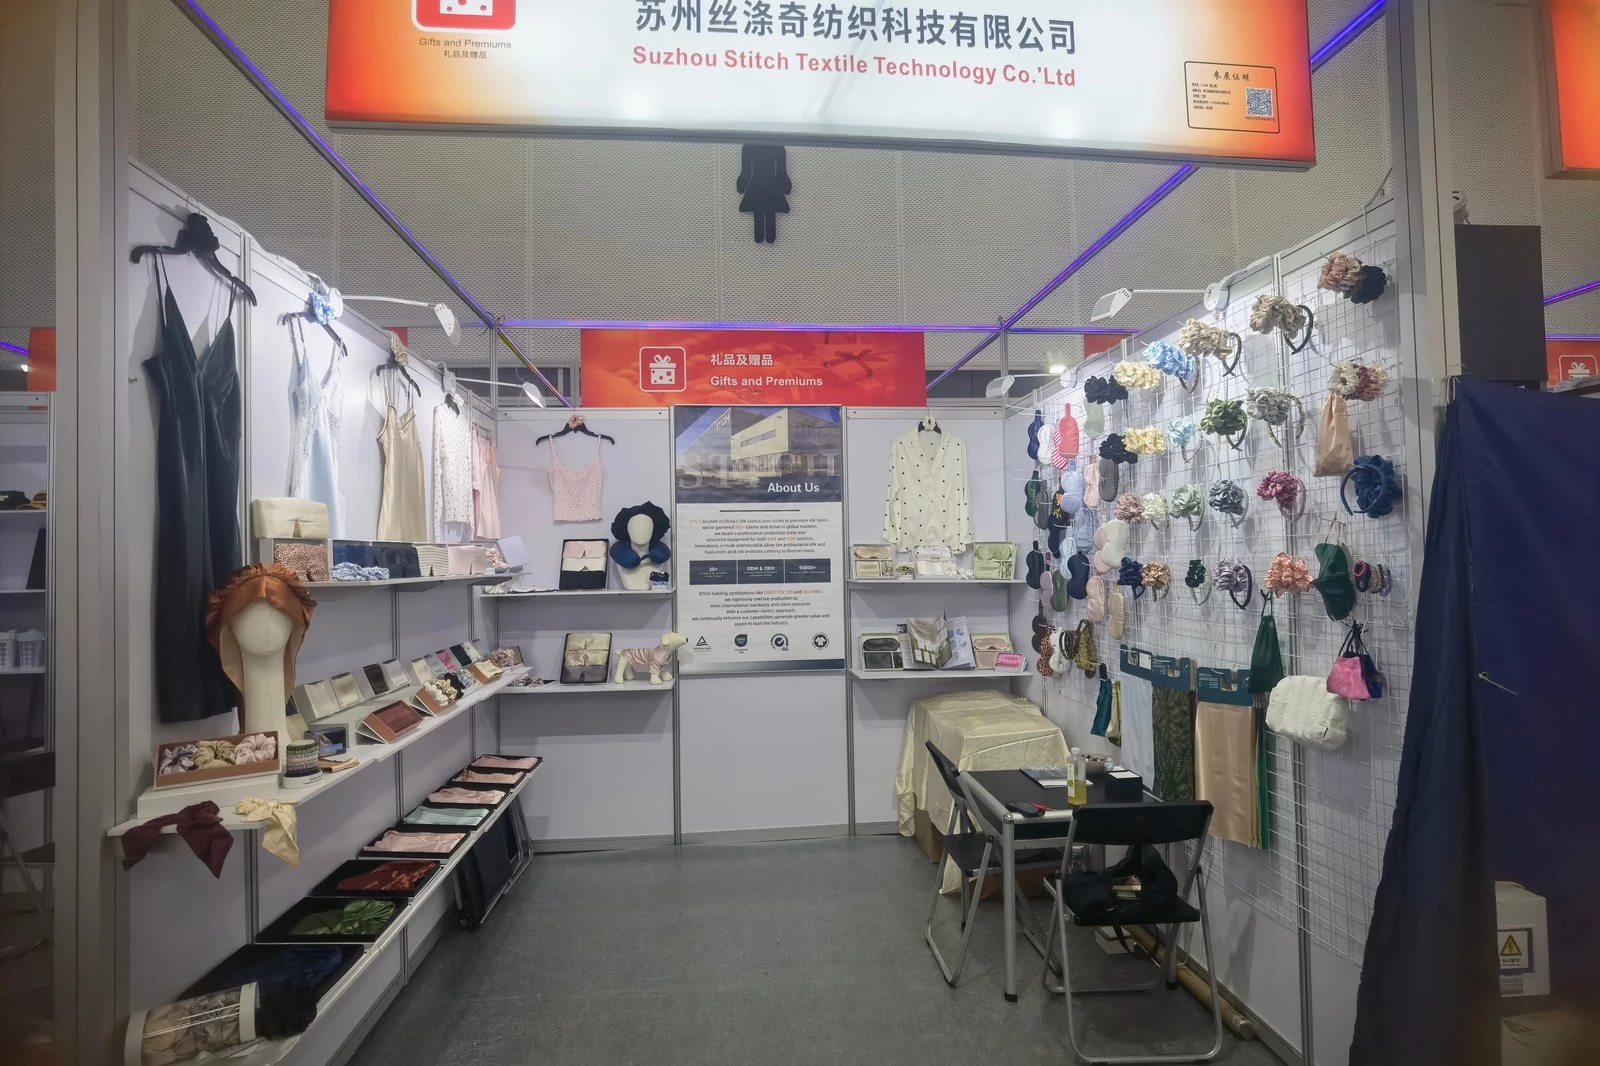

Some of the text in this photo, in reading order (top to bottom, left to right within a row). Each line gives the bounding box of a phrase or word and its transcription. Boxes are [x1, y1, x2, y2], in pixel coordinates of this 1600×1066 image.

[635, 0, 1076, 54] 苏州丝涤奇纺织科技有限公司
[418, 38, 512, 49] Gifts and Premiums
[444, 50, 486, 59] 礼品及赠品
[632, 46, 717, 67] Suzhou
[724, 50, 788, 70] Stitch
[796, 53, 868, 73] Textile
[874, 56, 996, 85] Technology
[710, 354, 773, 366] 礼品及赠品
[710, 376, 822, 386] Gifts and Premiums
[767, 482, 820, 492] About Us
